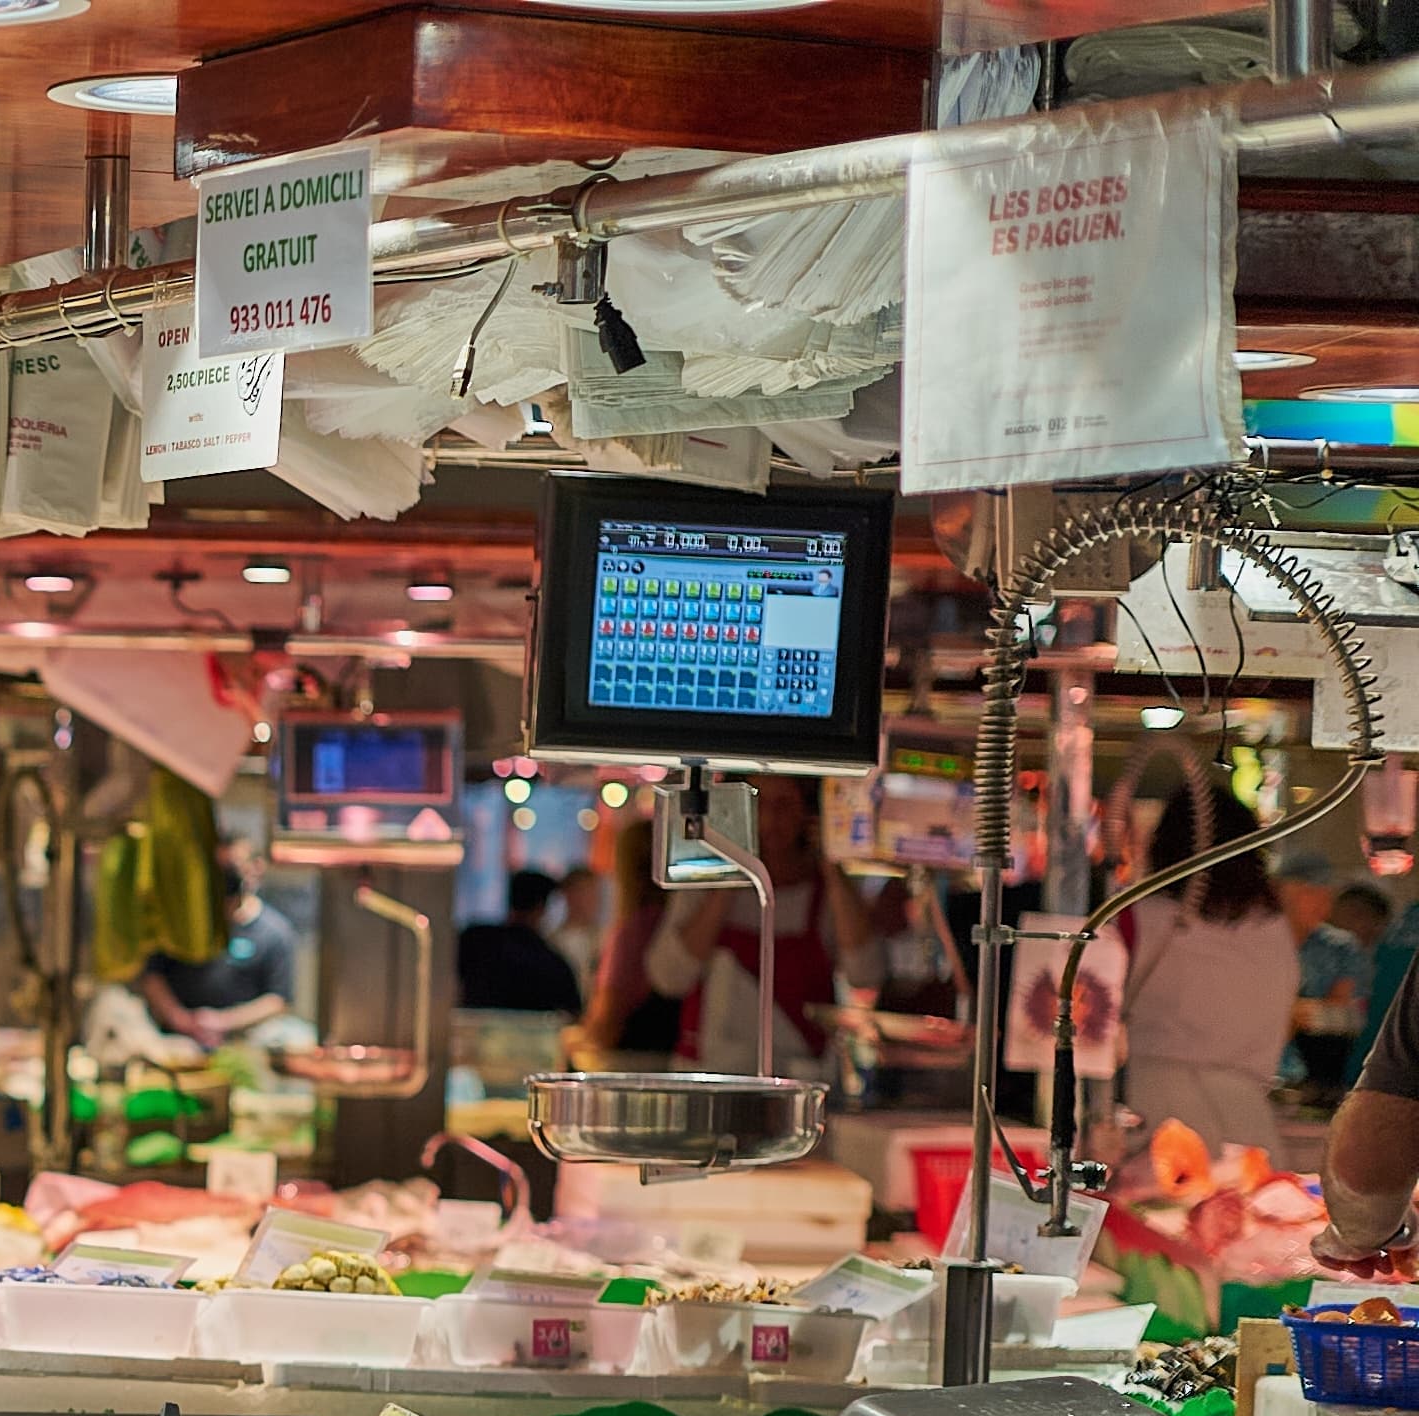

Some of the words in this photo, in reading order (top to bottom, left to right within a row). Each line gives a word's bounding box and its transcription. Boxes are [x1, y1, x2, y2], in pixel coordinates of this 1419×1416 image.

[205, 187, 259, 224] SERVEI
[263, 184, 276, 214] A
[280, 169, 364, 211] DOMICILI
[988, 190, 1030, 222] LES
[1036, 175, 1129, 215] BOSSES
[243, 234, 317, 273] GRATUIT
[991, 225, 1019, 256] ES
[1025, 211, 1125, 251] PAGUEN.
[230, 302, 260, 335] 933
[265, 299, 294, 329] 011
[300, 293, 331, 324] 476
[158, 326, 190, 348] OPEN
[171, 439, 201, 452] TABASCO
[203, 435, 220, 447] SALT
[225, 432, 251, 445] PEPPER
